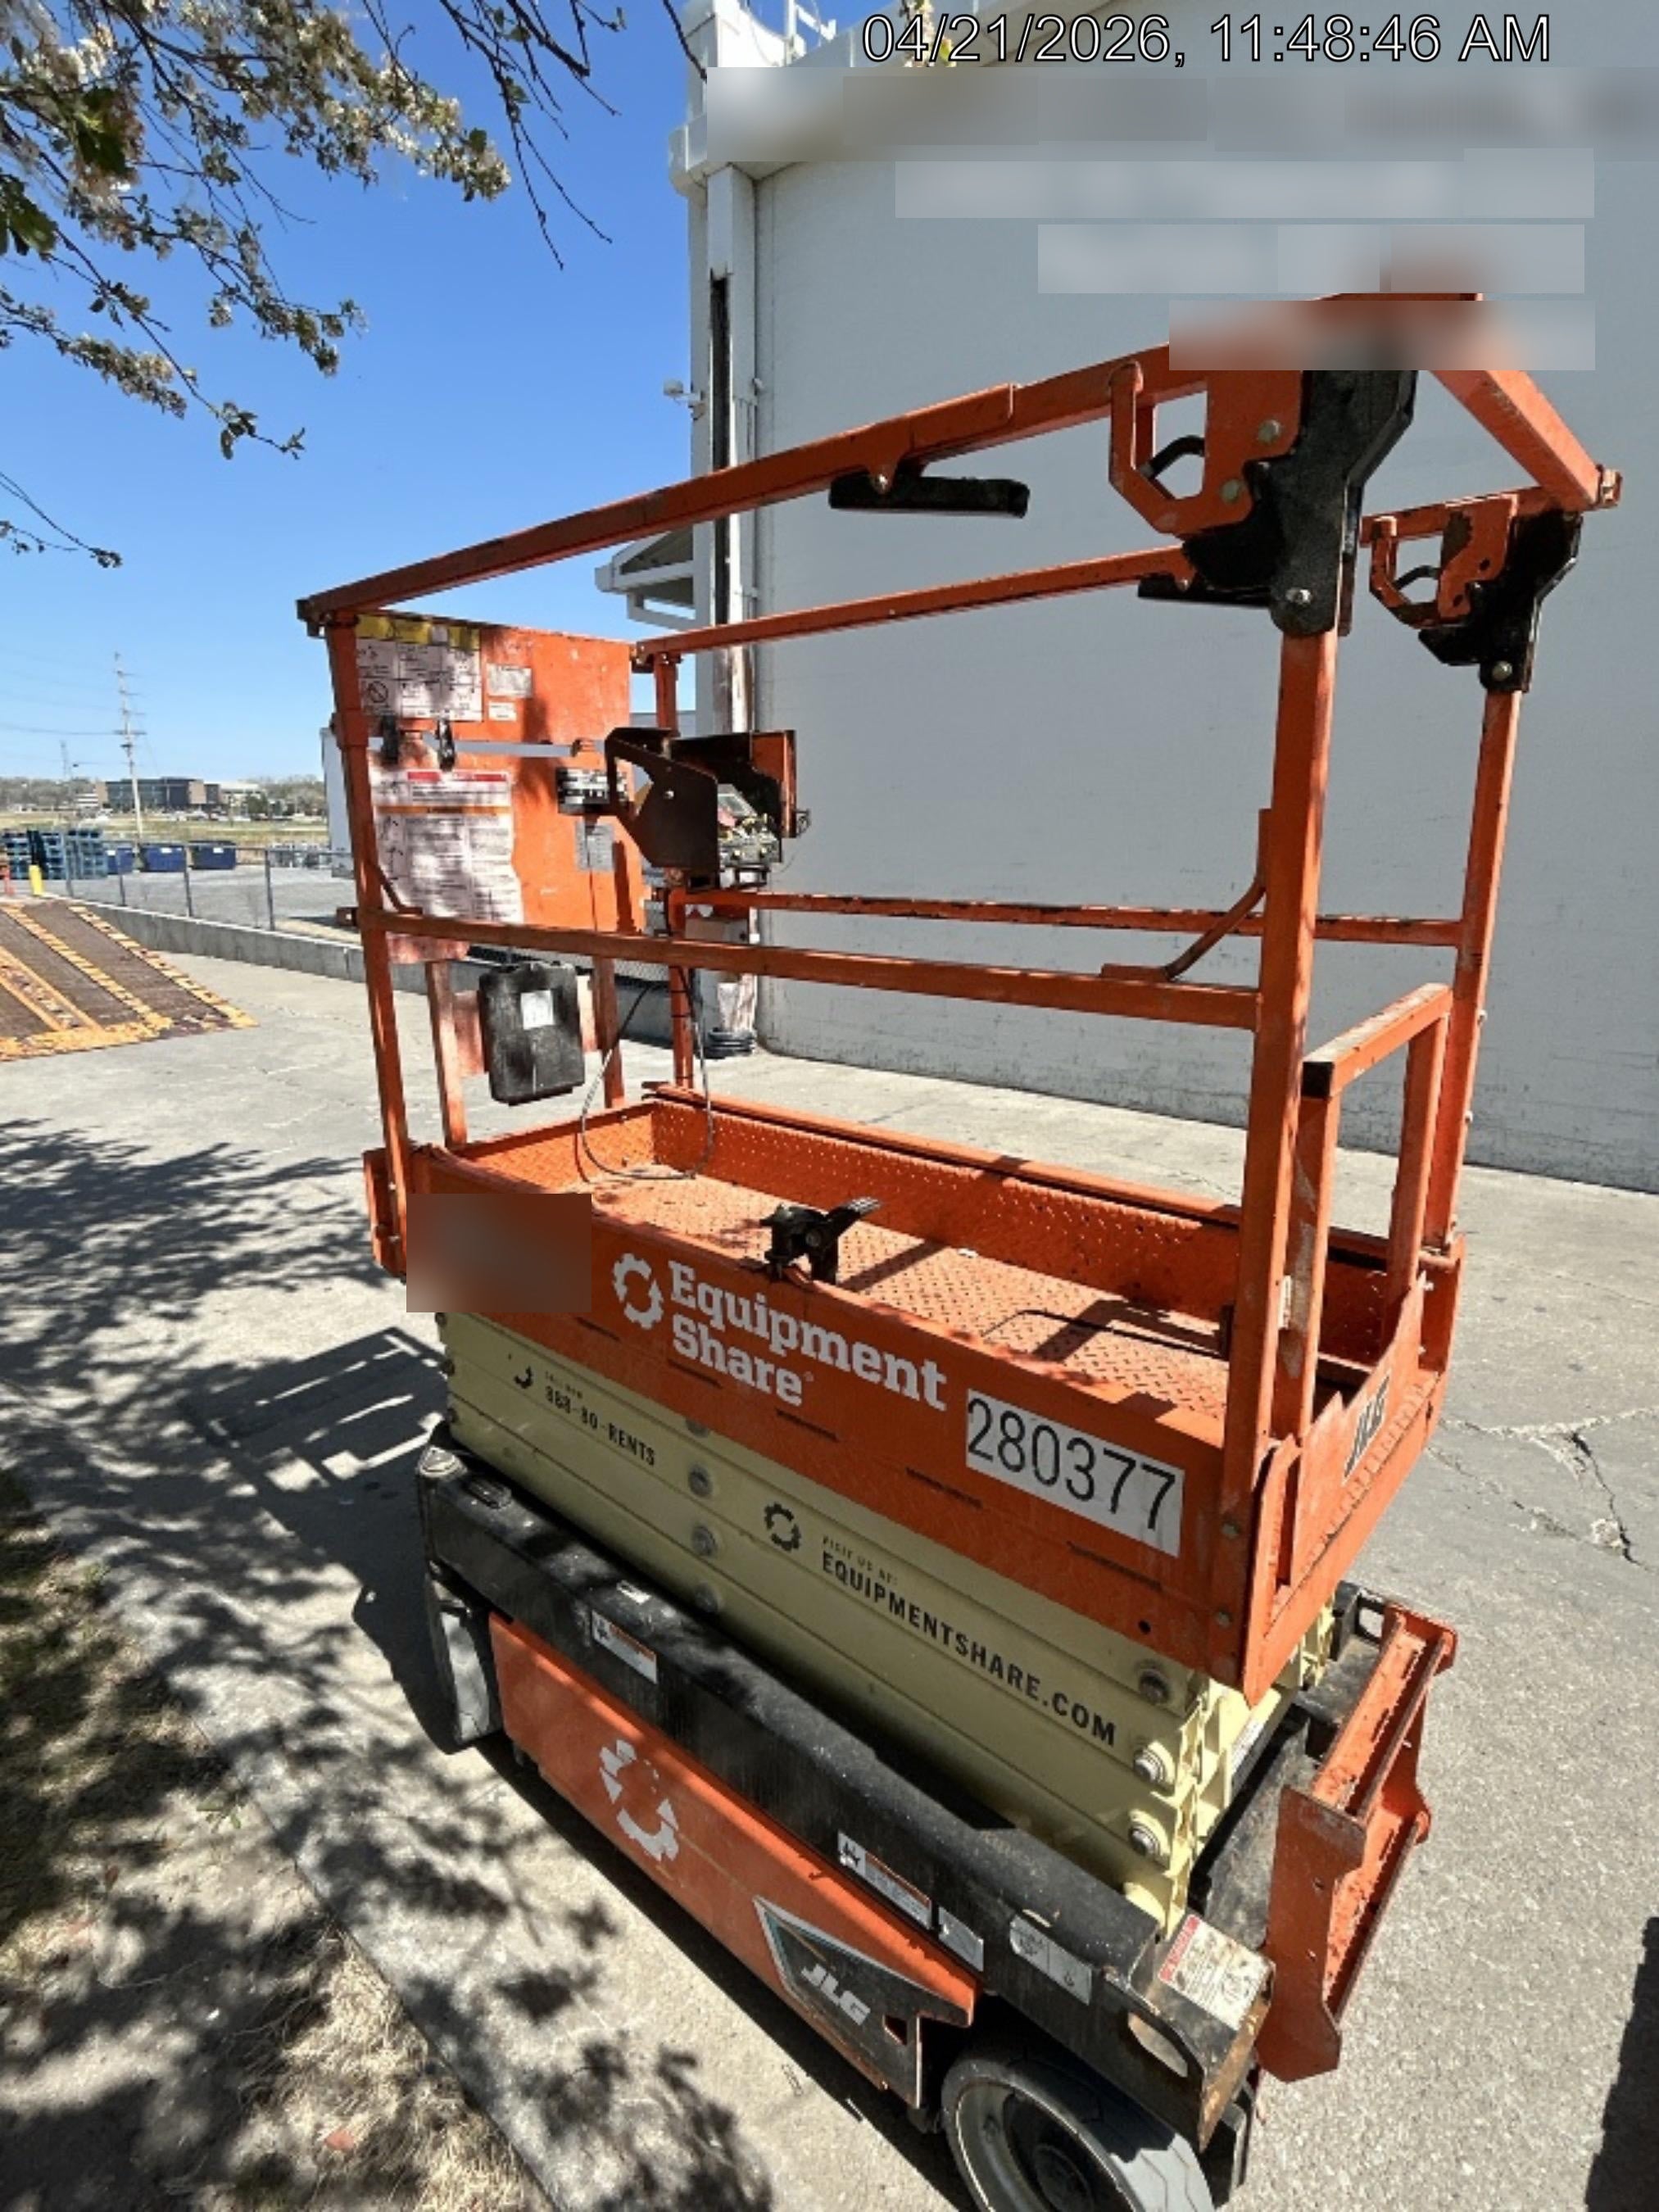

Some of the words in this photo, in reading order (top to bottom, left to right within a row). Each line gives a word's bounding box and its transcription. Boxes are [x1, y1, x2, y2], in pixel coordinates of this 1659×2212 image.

[669, 1260, 947, 1412] Equipment
[968, 1398, 1176, 1530] 280377
[823, 1551, 1116, 1747] EQUIPMENTSHARE.COM
[801, 1963, 872, 2026] JLG
